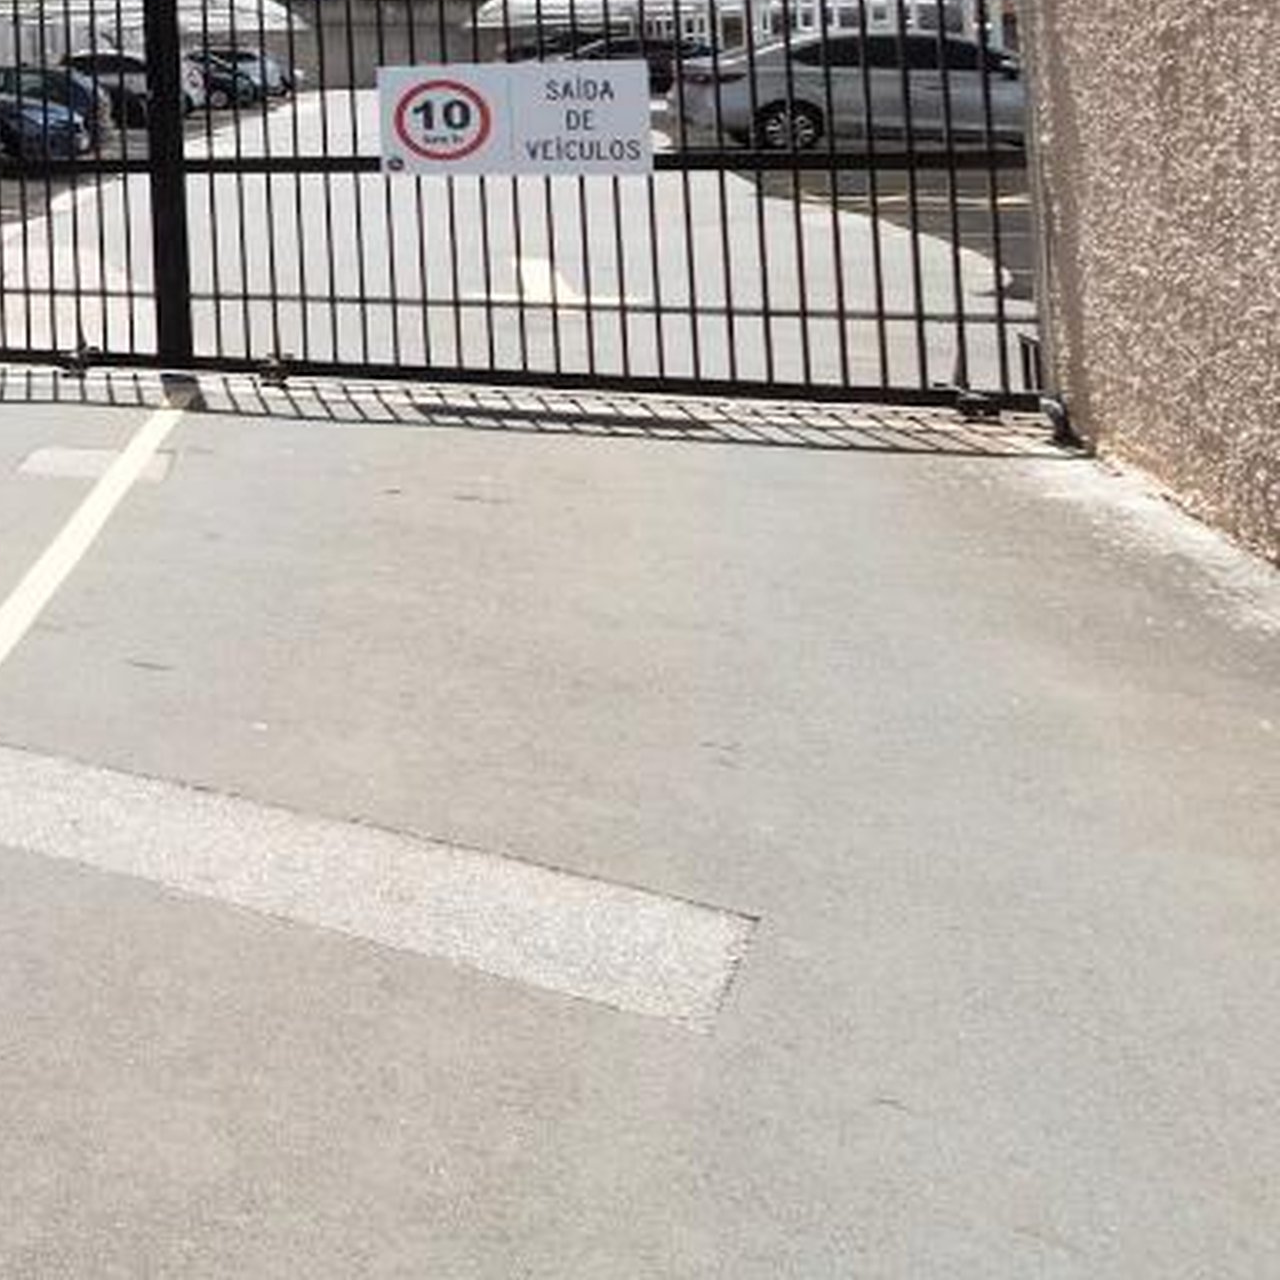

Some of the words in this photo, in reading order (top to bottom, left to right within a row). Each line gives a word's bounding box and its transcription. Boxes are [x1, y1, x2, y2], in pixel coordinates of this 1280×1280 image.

[544, 78, 615, 101] SAÍDA
[412, 99, 471, 130] 10
[565, 110, 595, 131] DE
[525, 137, 641, 161] VEÍCULOS
